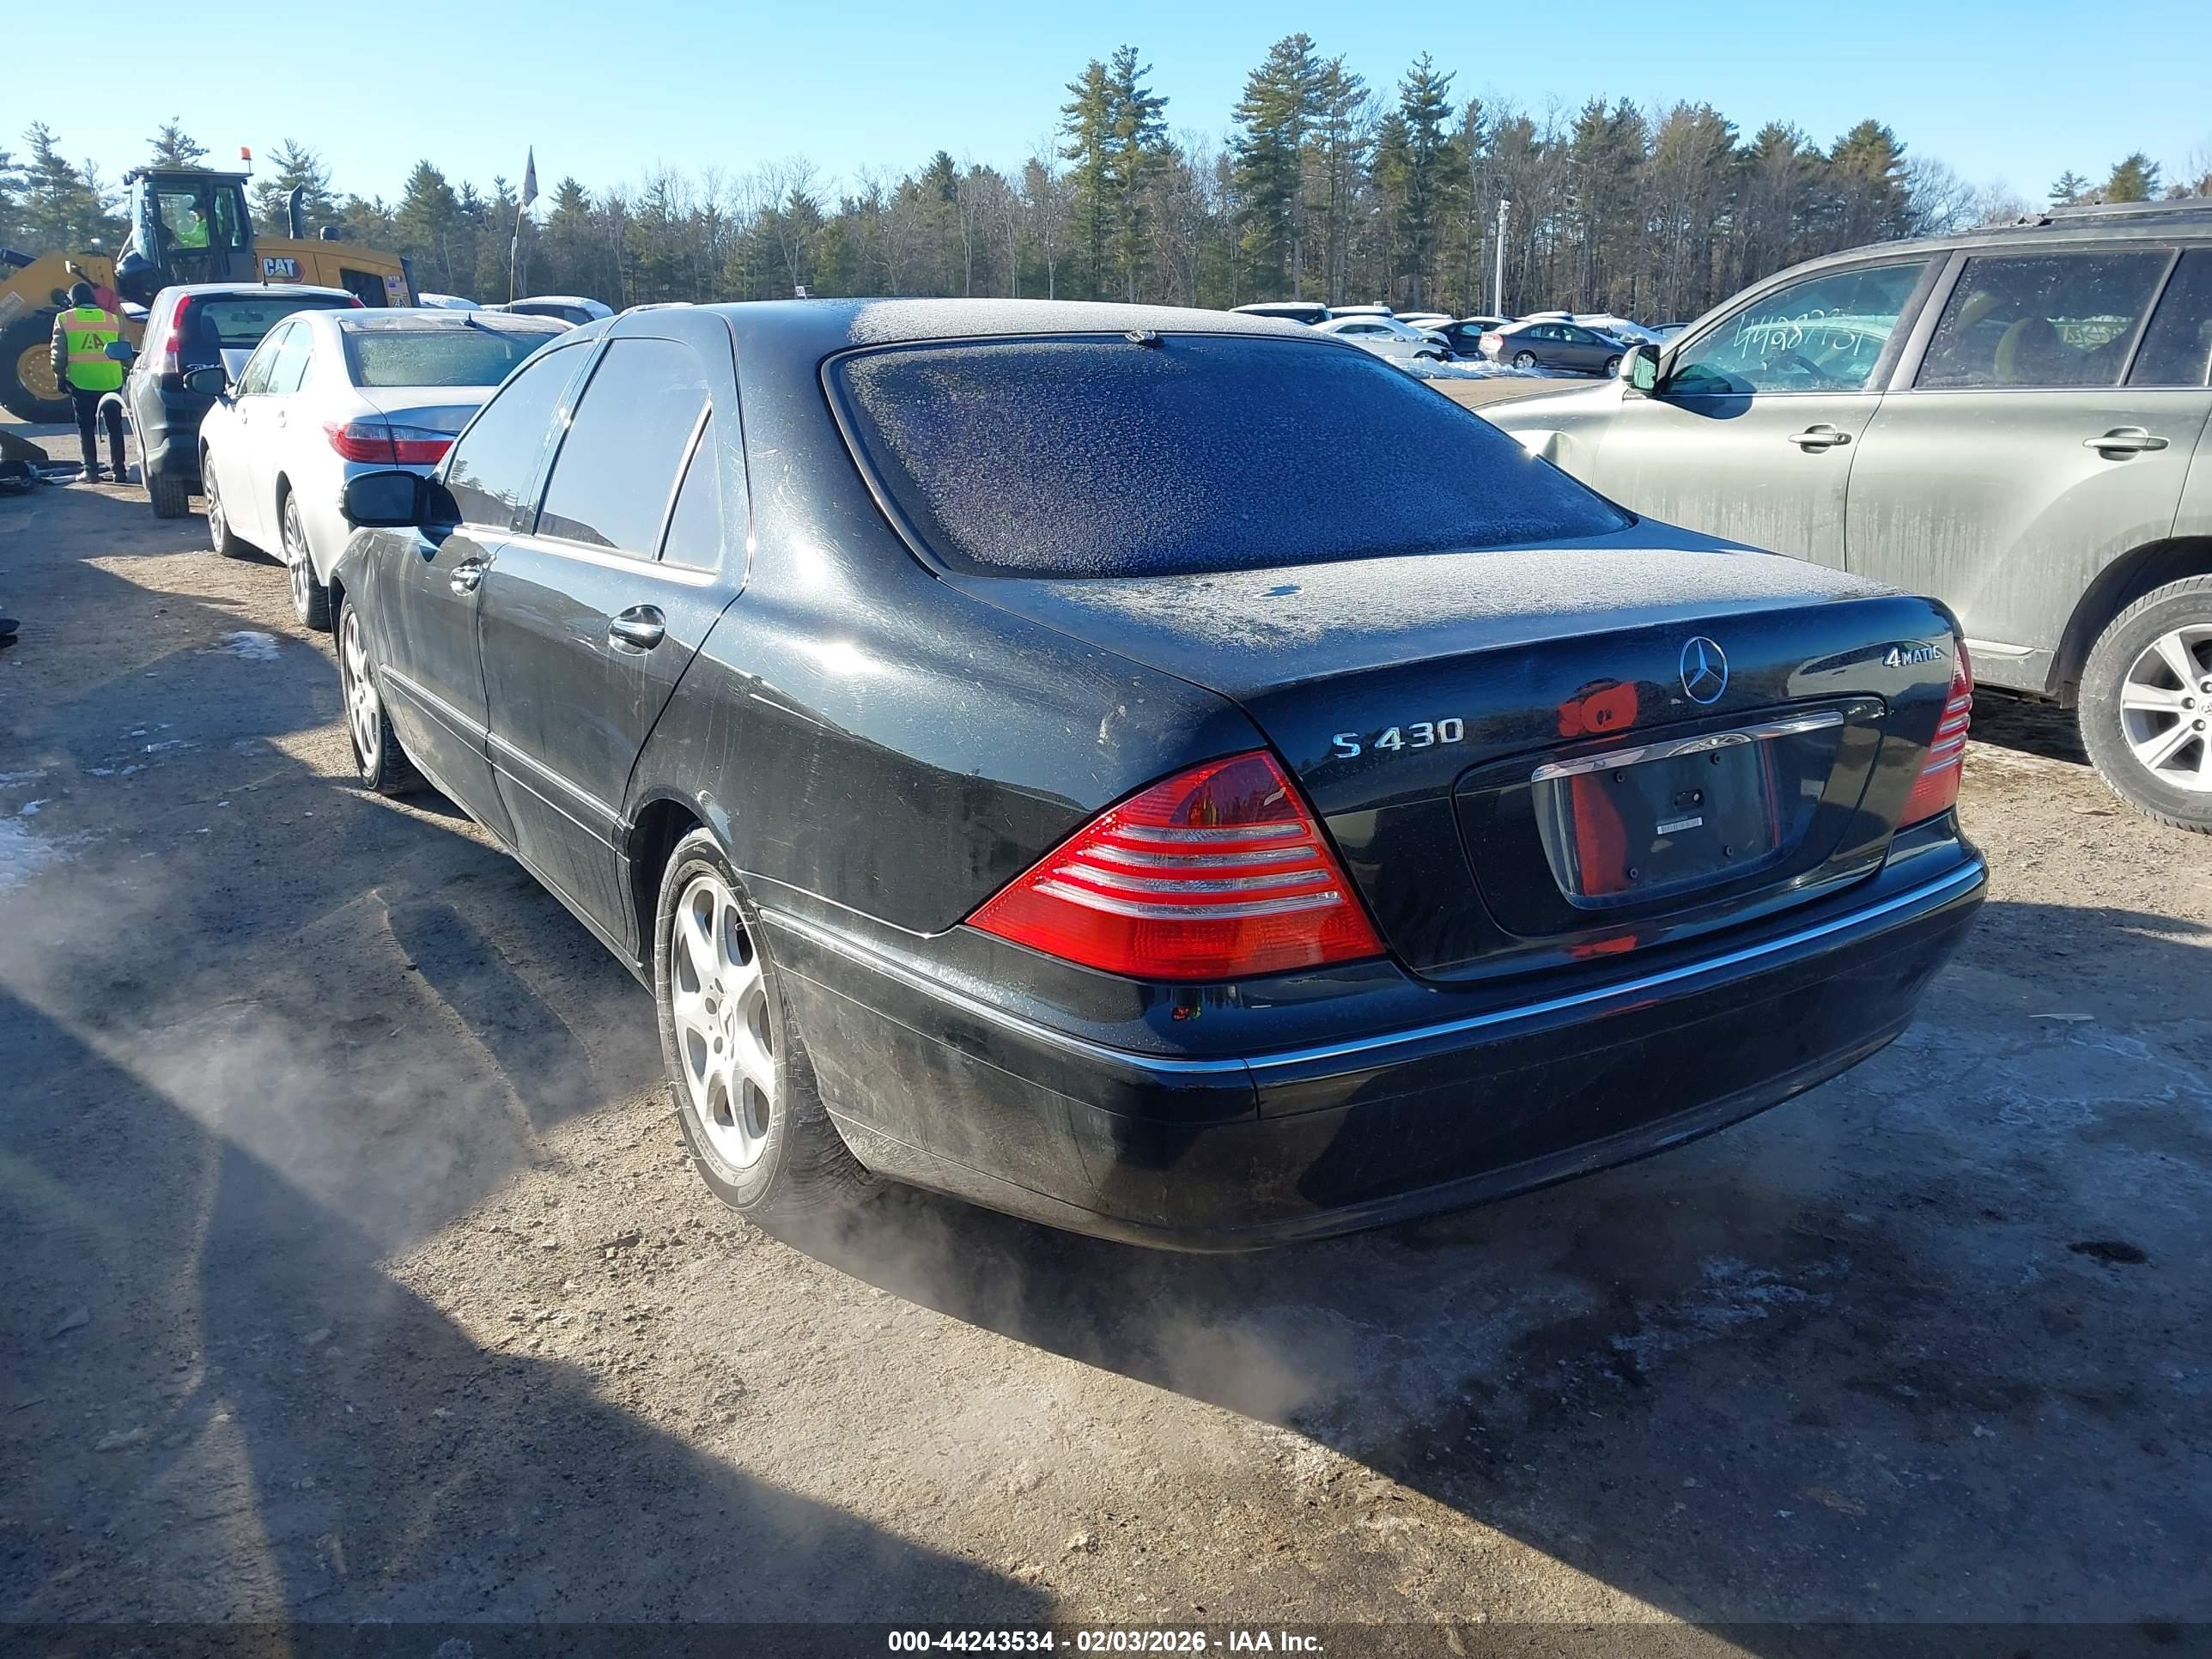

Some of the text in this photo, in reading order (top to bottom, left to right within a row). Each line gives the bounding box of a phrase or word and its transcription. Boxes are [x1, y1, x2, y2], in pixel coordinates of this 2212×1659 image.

[263, 258, 295, 277] CAT
[1883, 645, 1945, 667] 4MATIC
[1332, 717, 1465, 759] S 430
